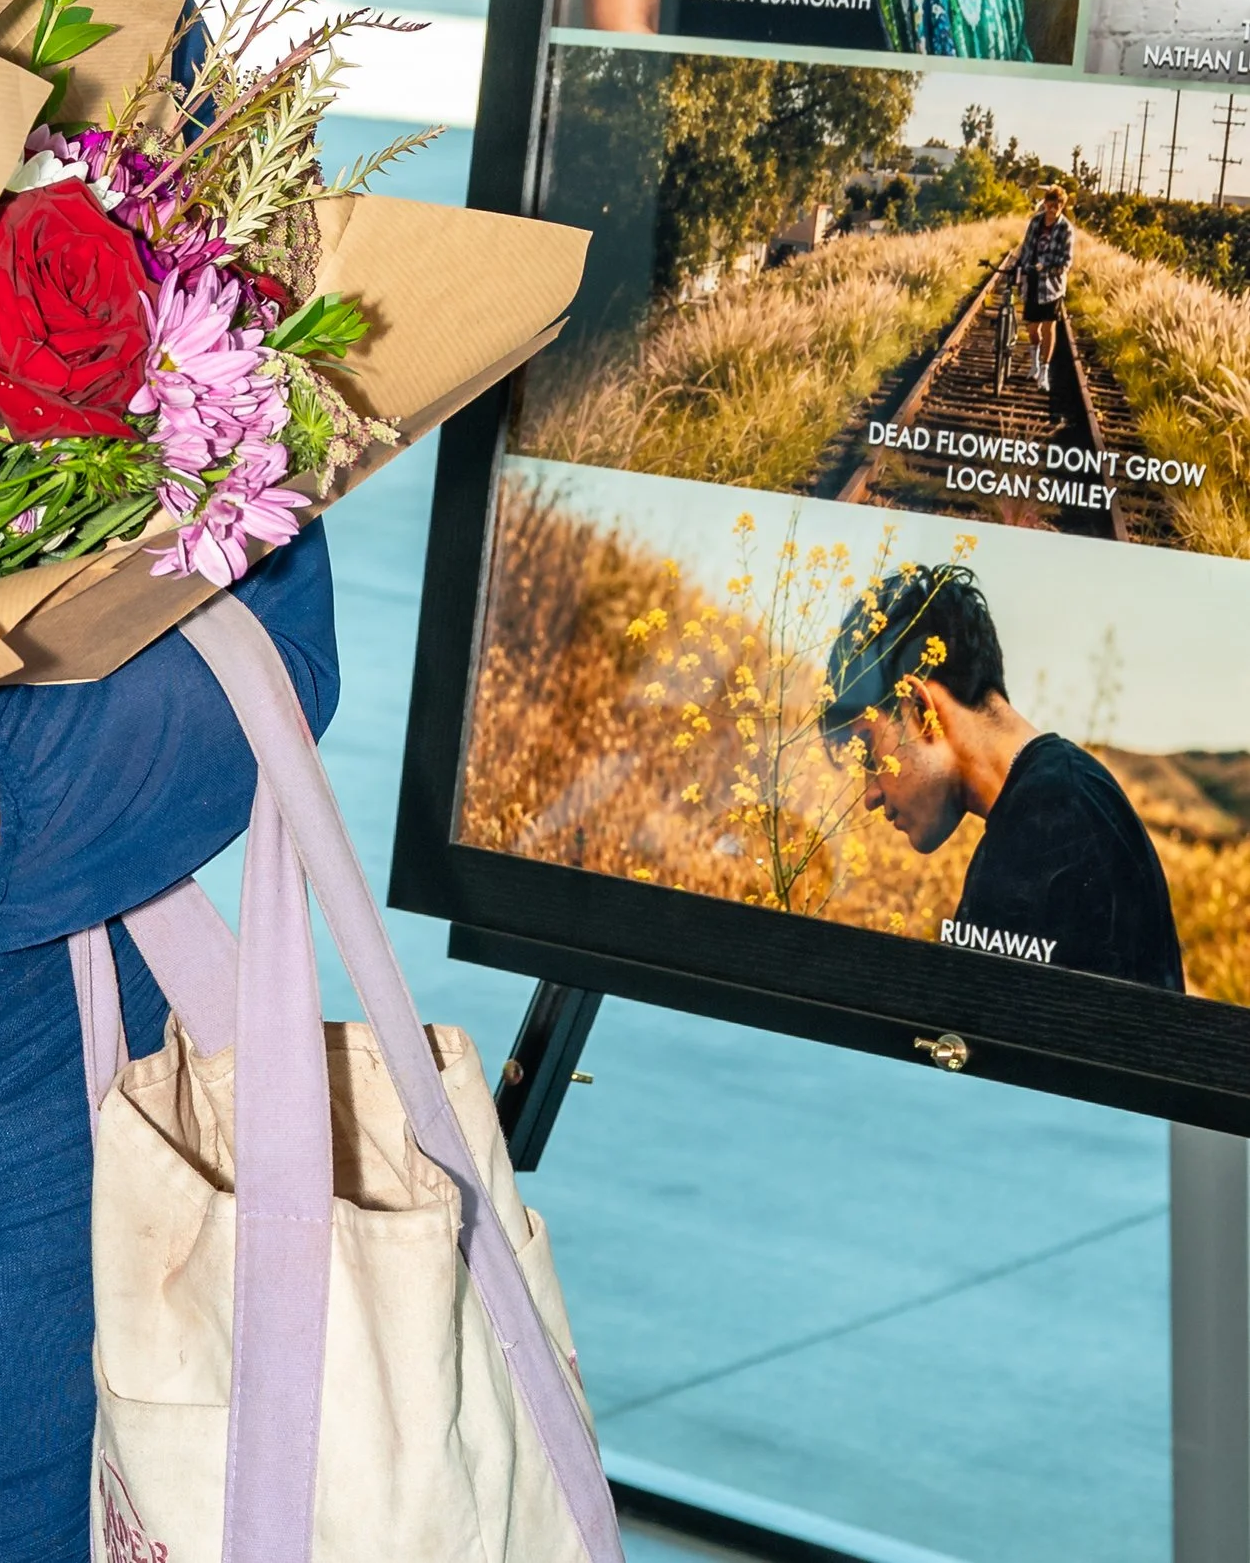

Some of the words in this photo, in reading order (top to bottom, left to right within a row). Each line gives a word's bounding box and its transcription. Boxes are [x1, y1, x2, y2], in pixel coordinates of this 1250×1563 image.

[1143, 44, 1232, 71] NATHAN
[868, 421, 931, 451] DEAD
[936, 430, 1040, 467] FLOWERS
[1046, 445, 1121, 477] DON'T
[1125, 455, 1207, 488] GROW
[945, 465, 1032, 500] LOGAN
[1037, 477, 1118, 511] SMILEY
[940, 918, 1058, 963] RUNAWAY
